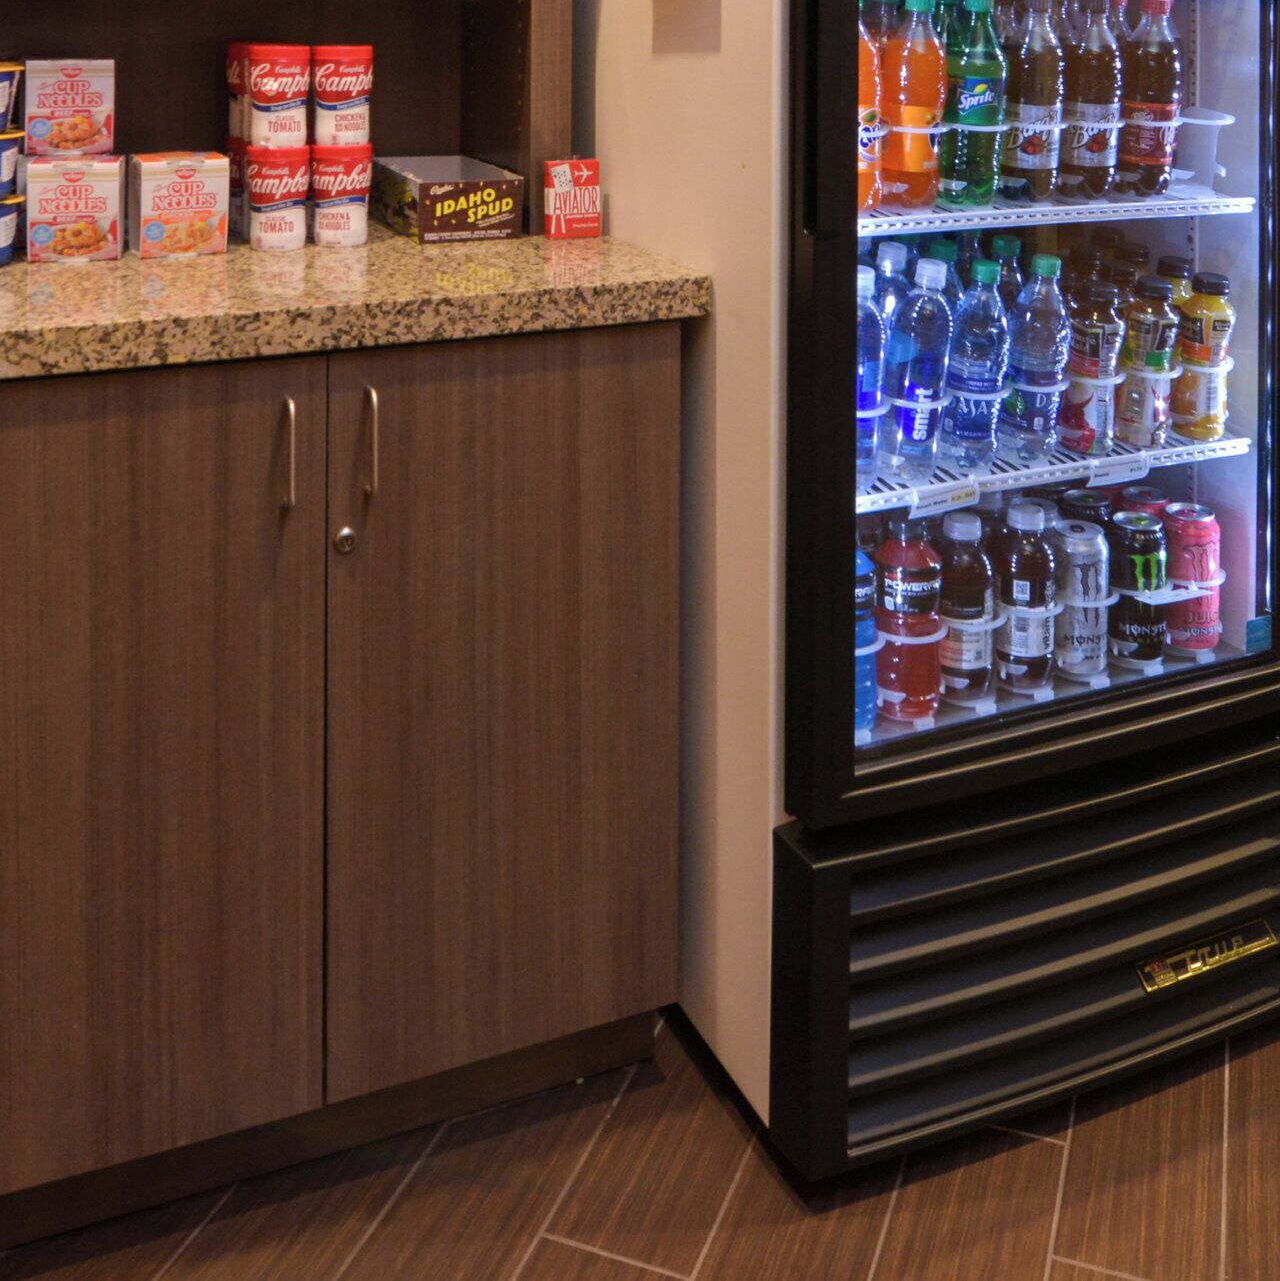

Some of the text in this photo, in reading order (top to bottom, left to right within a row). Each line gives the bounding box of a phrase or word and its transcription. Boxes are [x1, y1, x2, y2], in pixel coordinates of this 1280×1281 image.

[52, 79, 91, 95] CUP
[36, 91, 104, 110] NOODLES
[957, 91, 995, 111] Sprite
[268, 120, 302, 133] TOMATO
[55, 185, 95, 200] CUP
[166, 181, 205, 196] CUP
[38, 197, 108, 215] NOODLES
[151, 192, 217, 212] NOODLES
[434, 187, 497, 218] IDAHO
[466, 196, 514, 224] SPUD
[552, 187, 599, 235] AVIATOR
[258, 221, 294, 234] TOMATO
